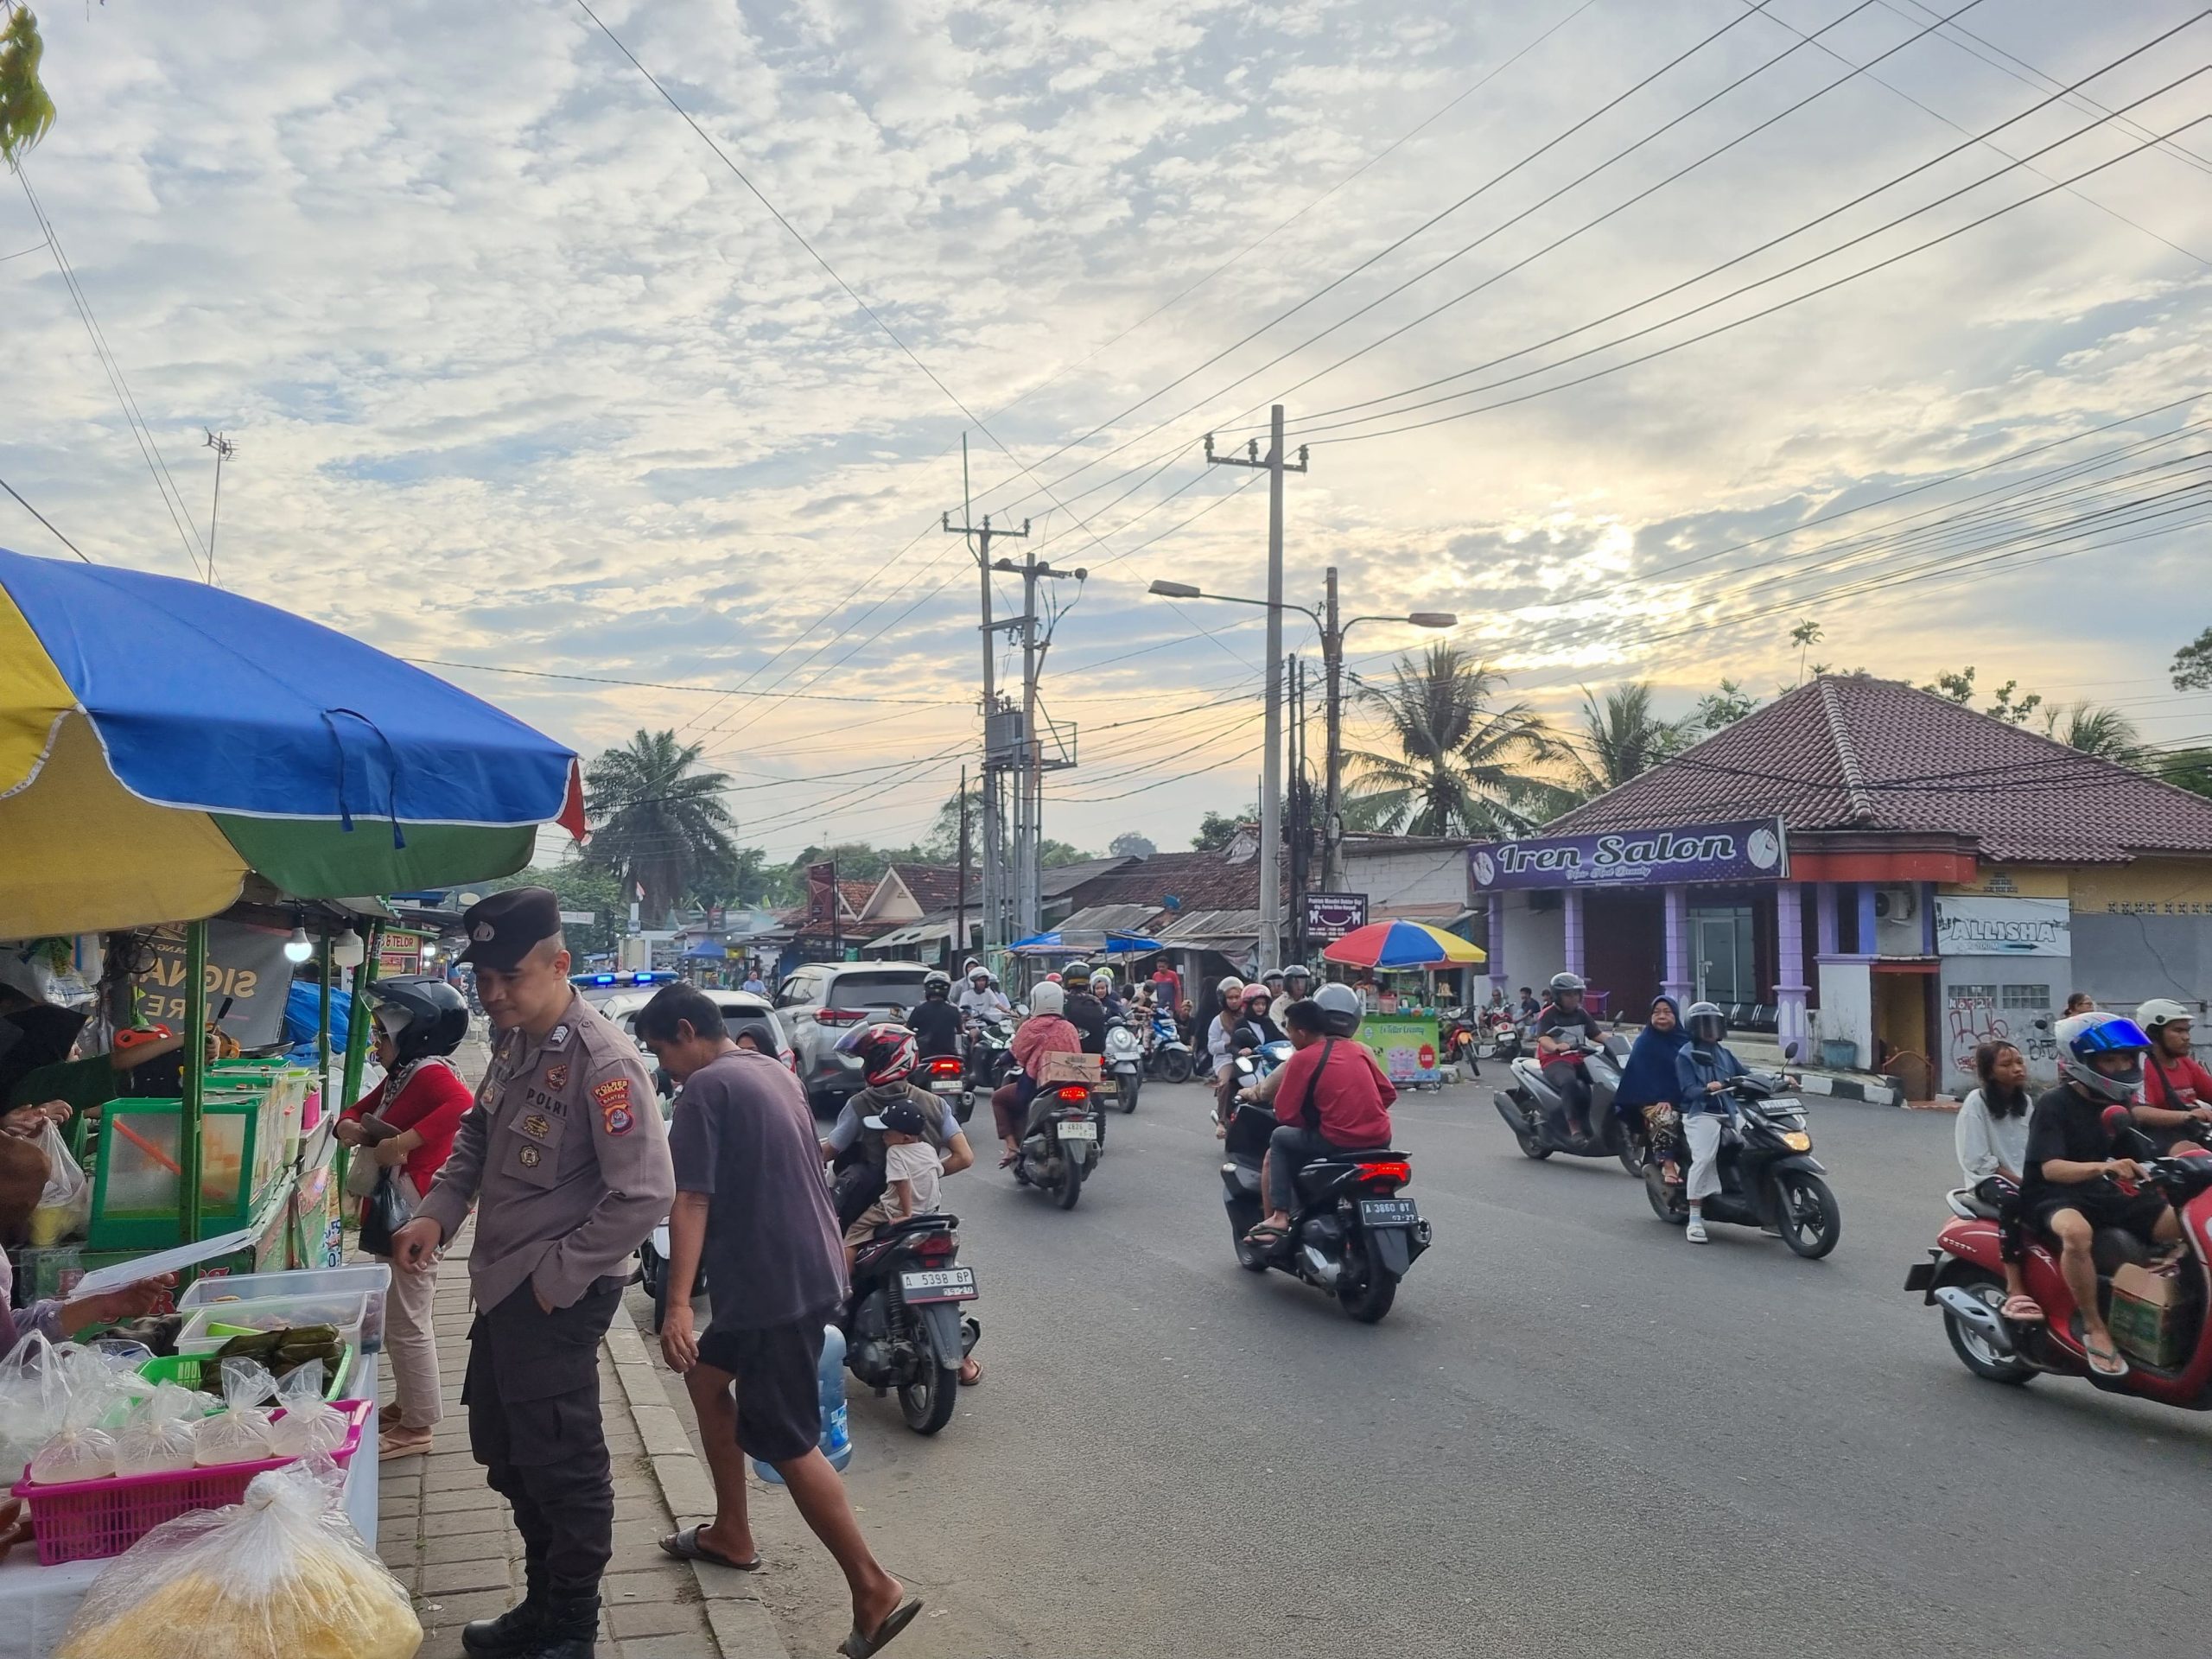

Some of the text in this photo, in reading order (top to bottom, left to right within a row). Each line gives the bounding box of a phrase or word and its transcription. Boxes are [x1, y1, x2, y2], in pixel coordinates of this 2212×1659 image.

[1497, 833, 1737, 873] Iren Salon
[1951, 921, 2056, 942] ALLISHA
[393, 936, 414, 947] TELOR
[526, 1088, 568, 1117] POLRI
[603, 1093, 626, 1103] BANTEN
[1366, 1204, 1371, 1213] A
[906, 1276, 912, 1287] A
[922, 1273, 949, 1285] 5398
